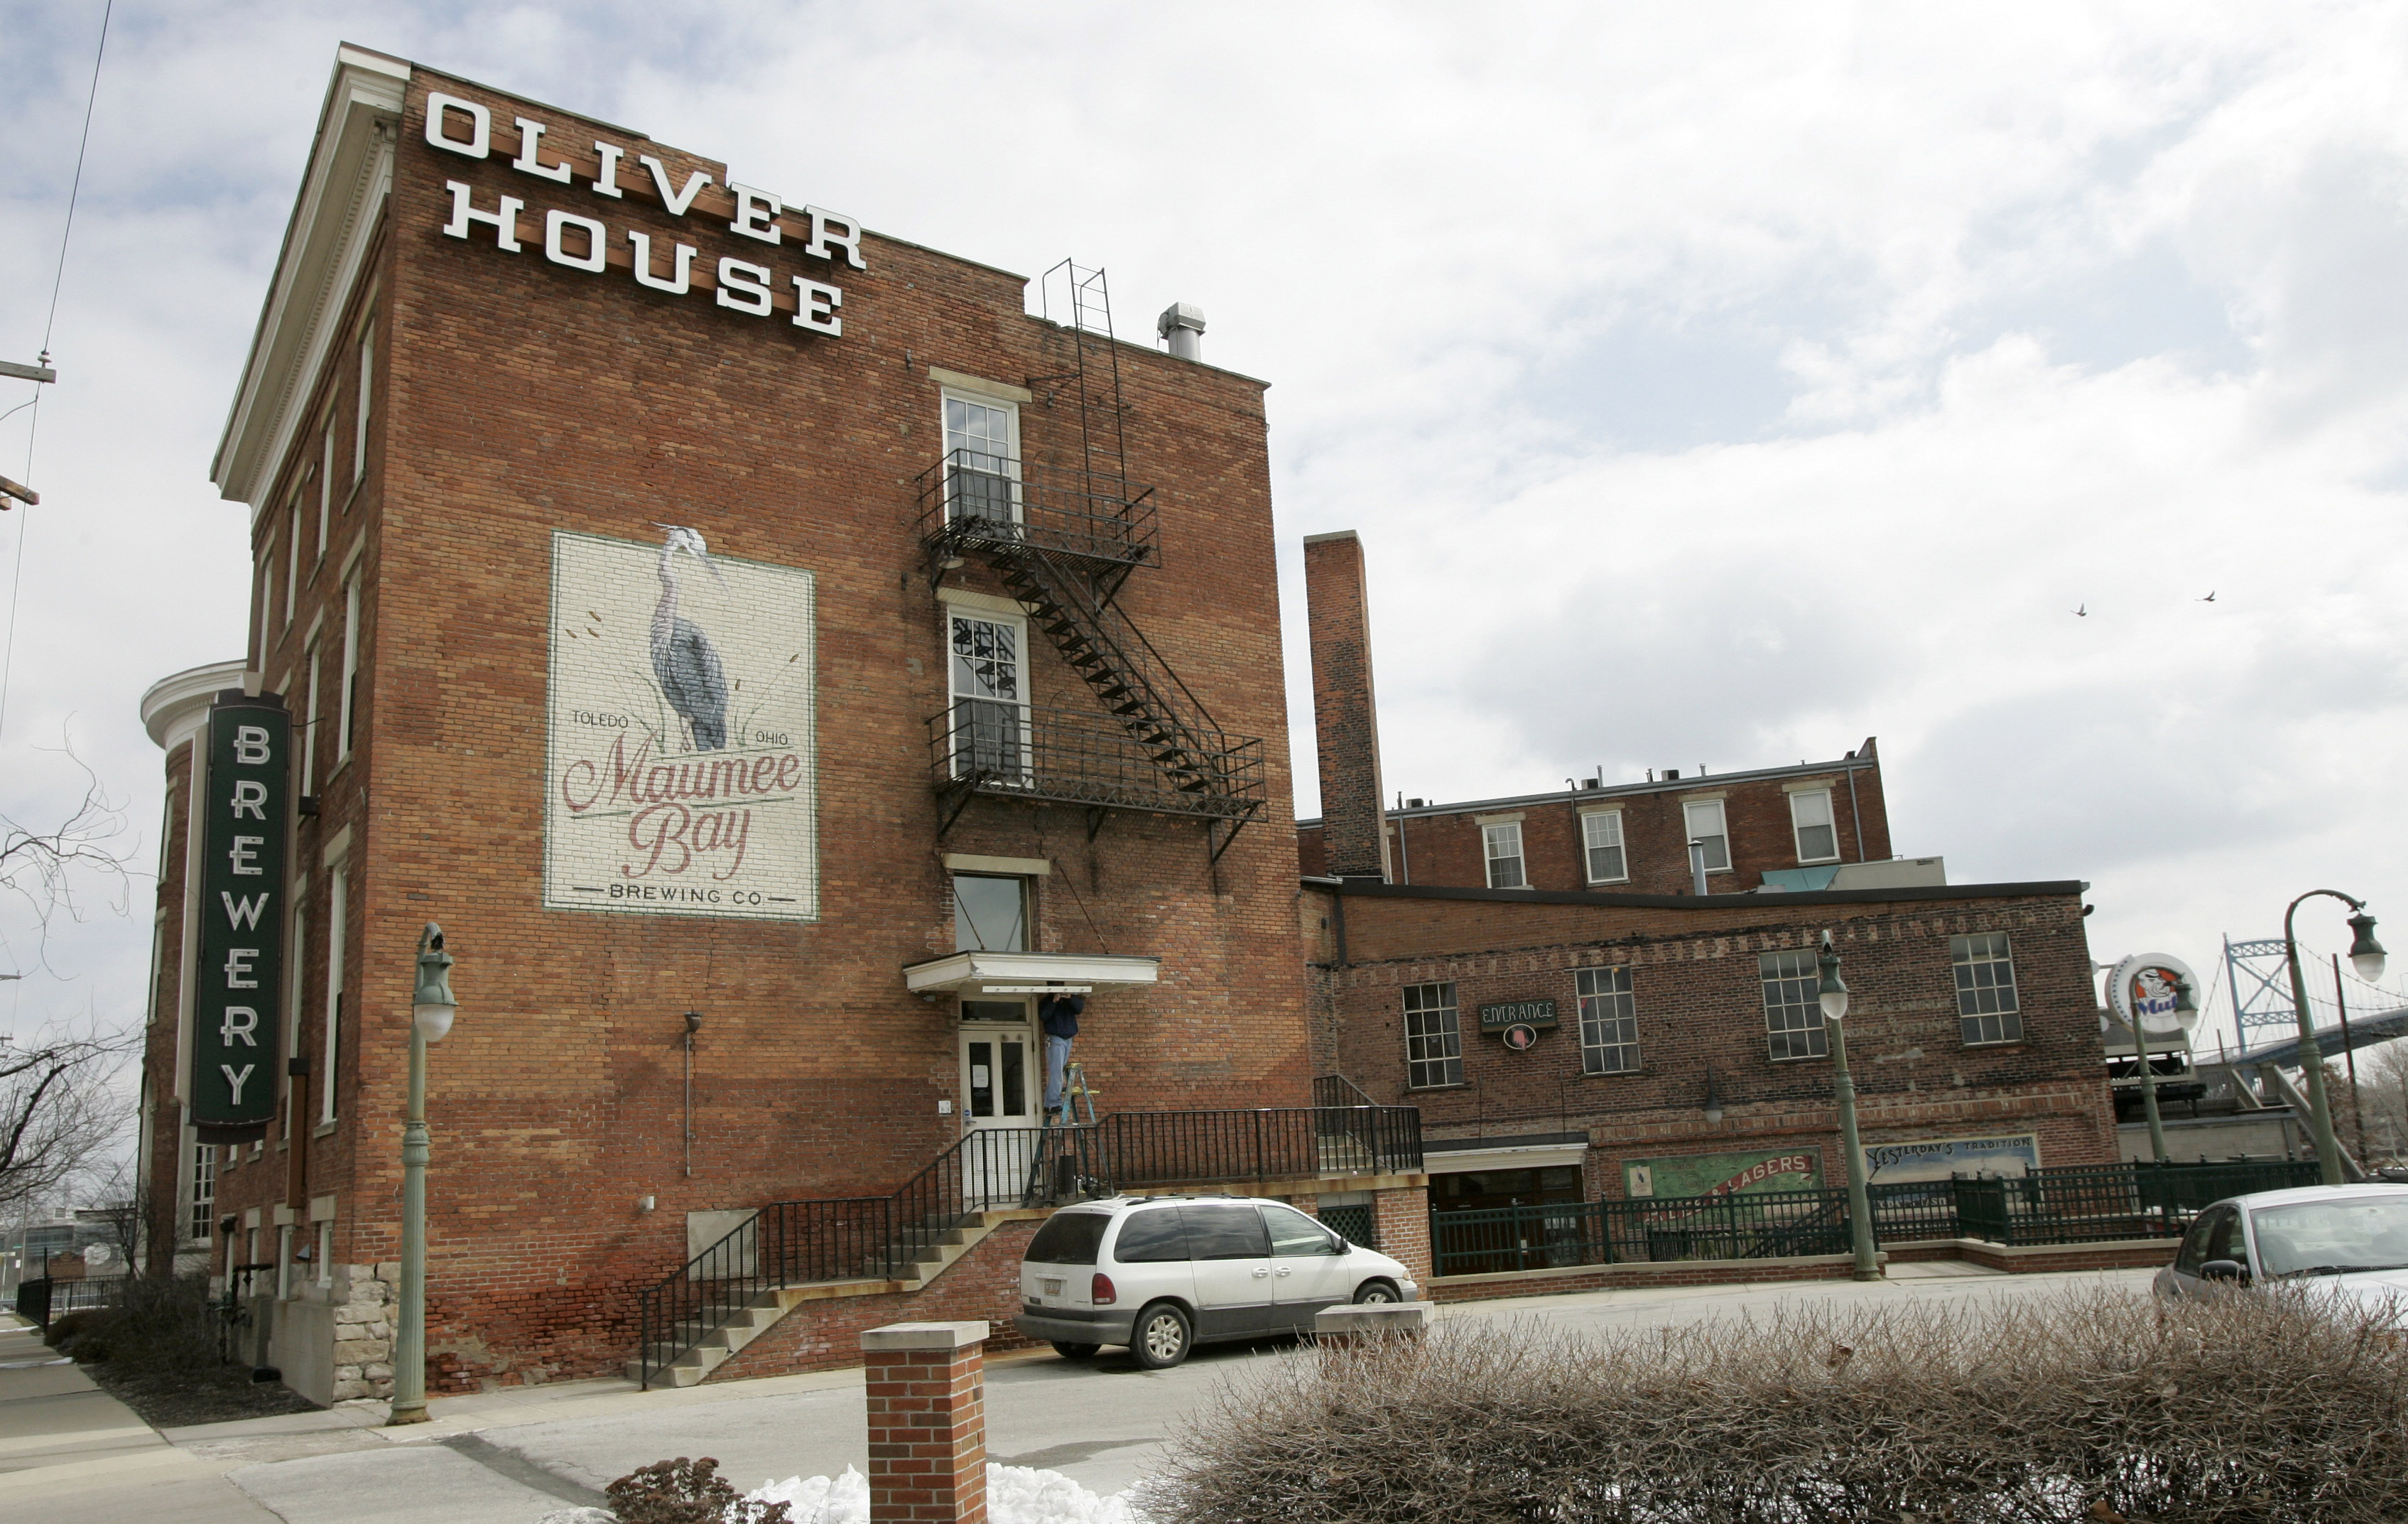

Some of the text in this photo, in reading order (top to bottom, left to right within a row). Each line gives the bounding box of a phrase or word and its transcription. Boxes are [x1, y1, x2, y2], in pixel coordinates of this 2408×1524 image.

[425, 91, 867, 270] OLIVER
[443, 179, 842, 337] HOUSE
[572, 710, 629, 728] TOLEDO
[756, 730, 788, 745] OHIO
[562, 731, 803, 812] Maumee
[622, 802, 751, 880] Bay
[609, 884, 721, 903] BREWING
[219, 725, 271, 1106] BREWERY
[1482, 1002, 1553, 1023] ENTRANCE
[1727, 1155, 1806, 1192] LAGERS
[1865, 1138, 2032, 1181] YESTERDAY'S TRADITION
